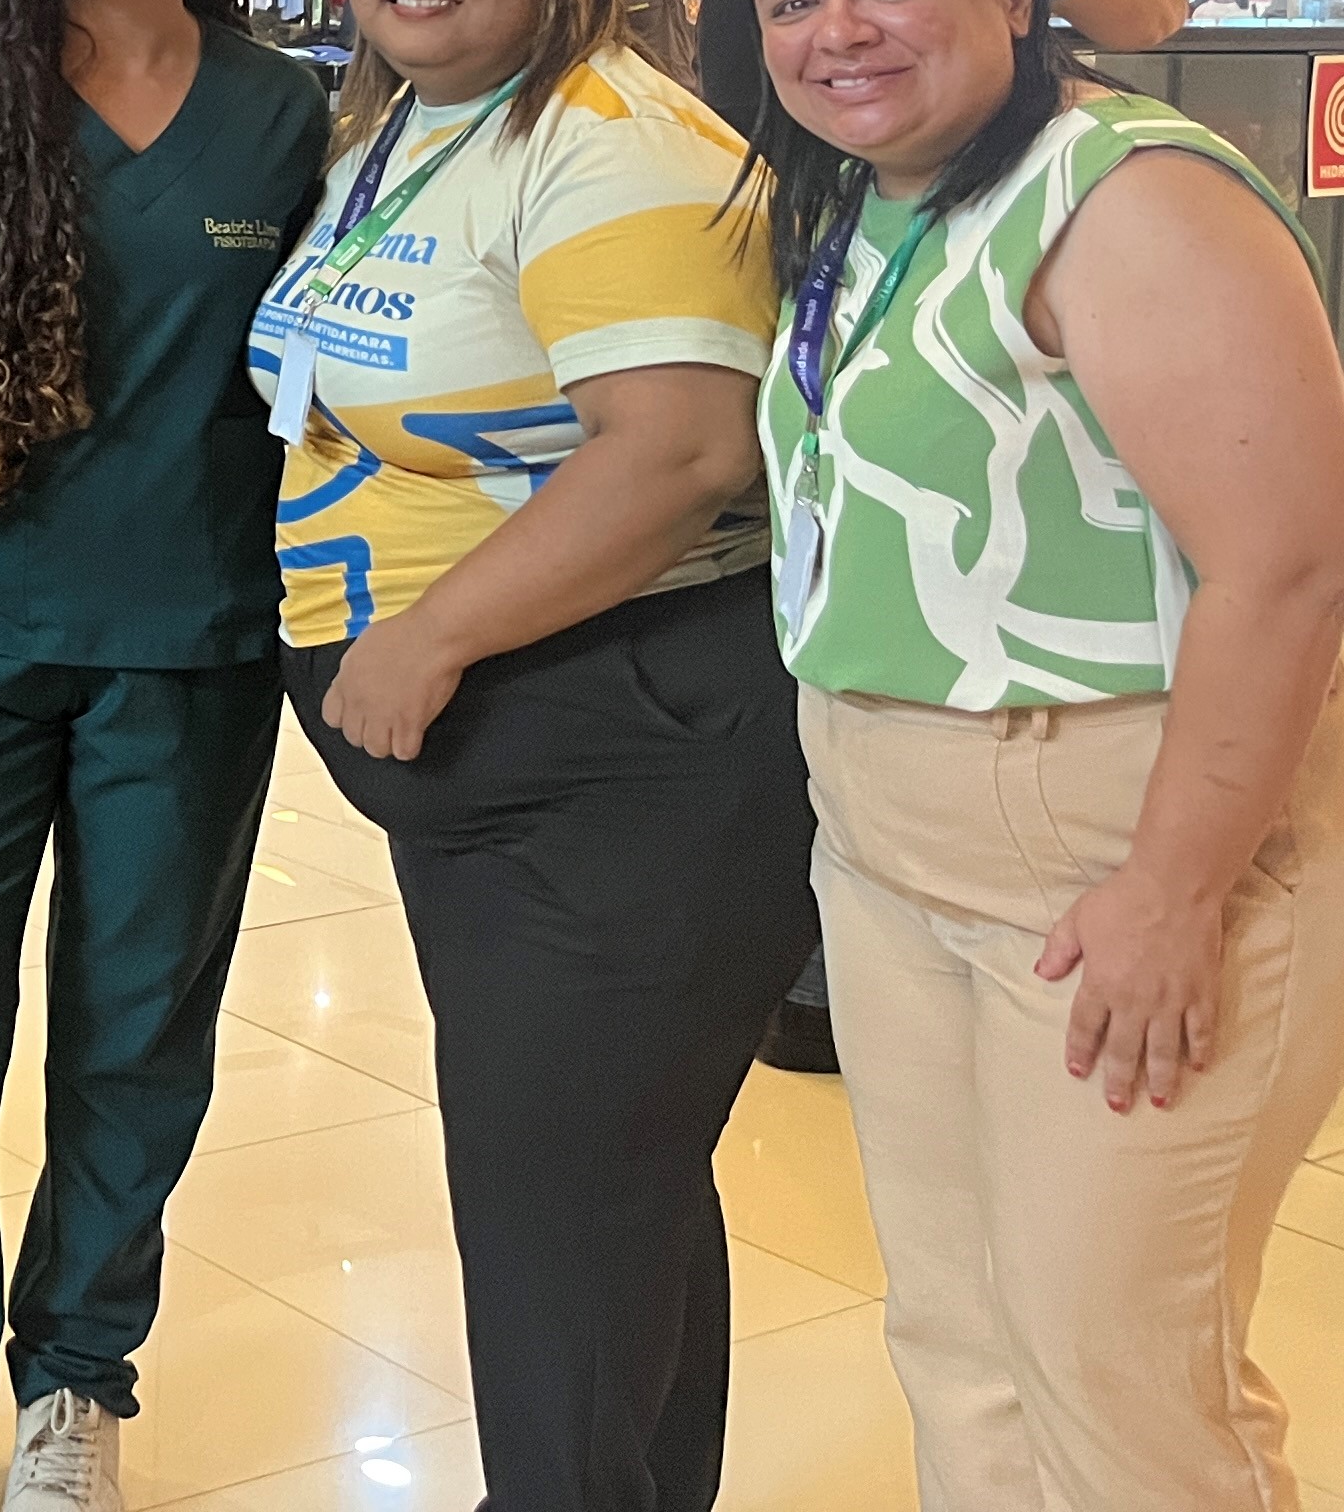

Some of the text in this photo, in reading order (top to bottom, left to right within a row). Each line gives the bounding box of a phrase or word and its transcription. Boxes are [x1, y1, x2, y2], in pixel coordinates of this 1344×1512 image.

[204, 217, 254, 235] Beatriz
[309, 320, 347, 341] ARTIDA
[349, 332, 392, 352] PARA
